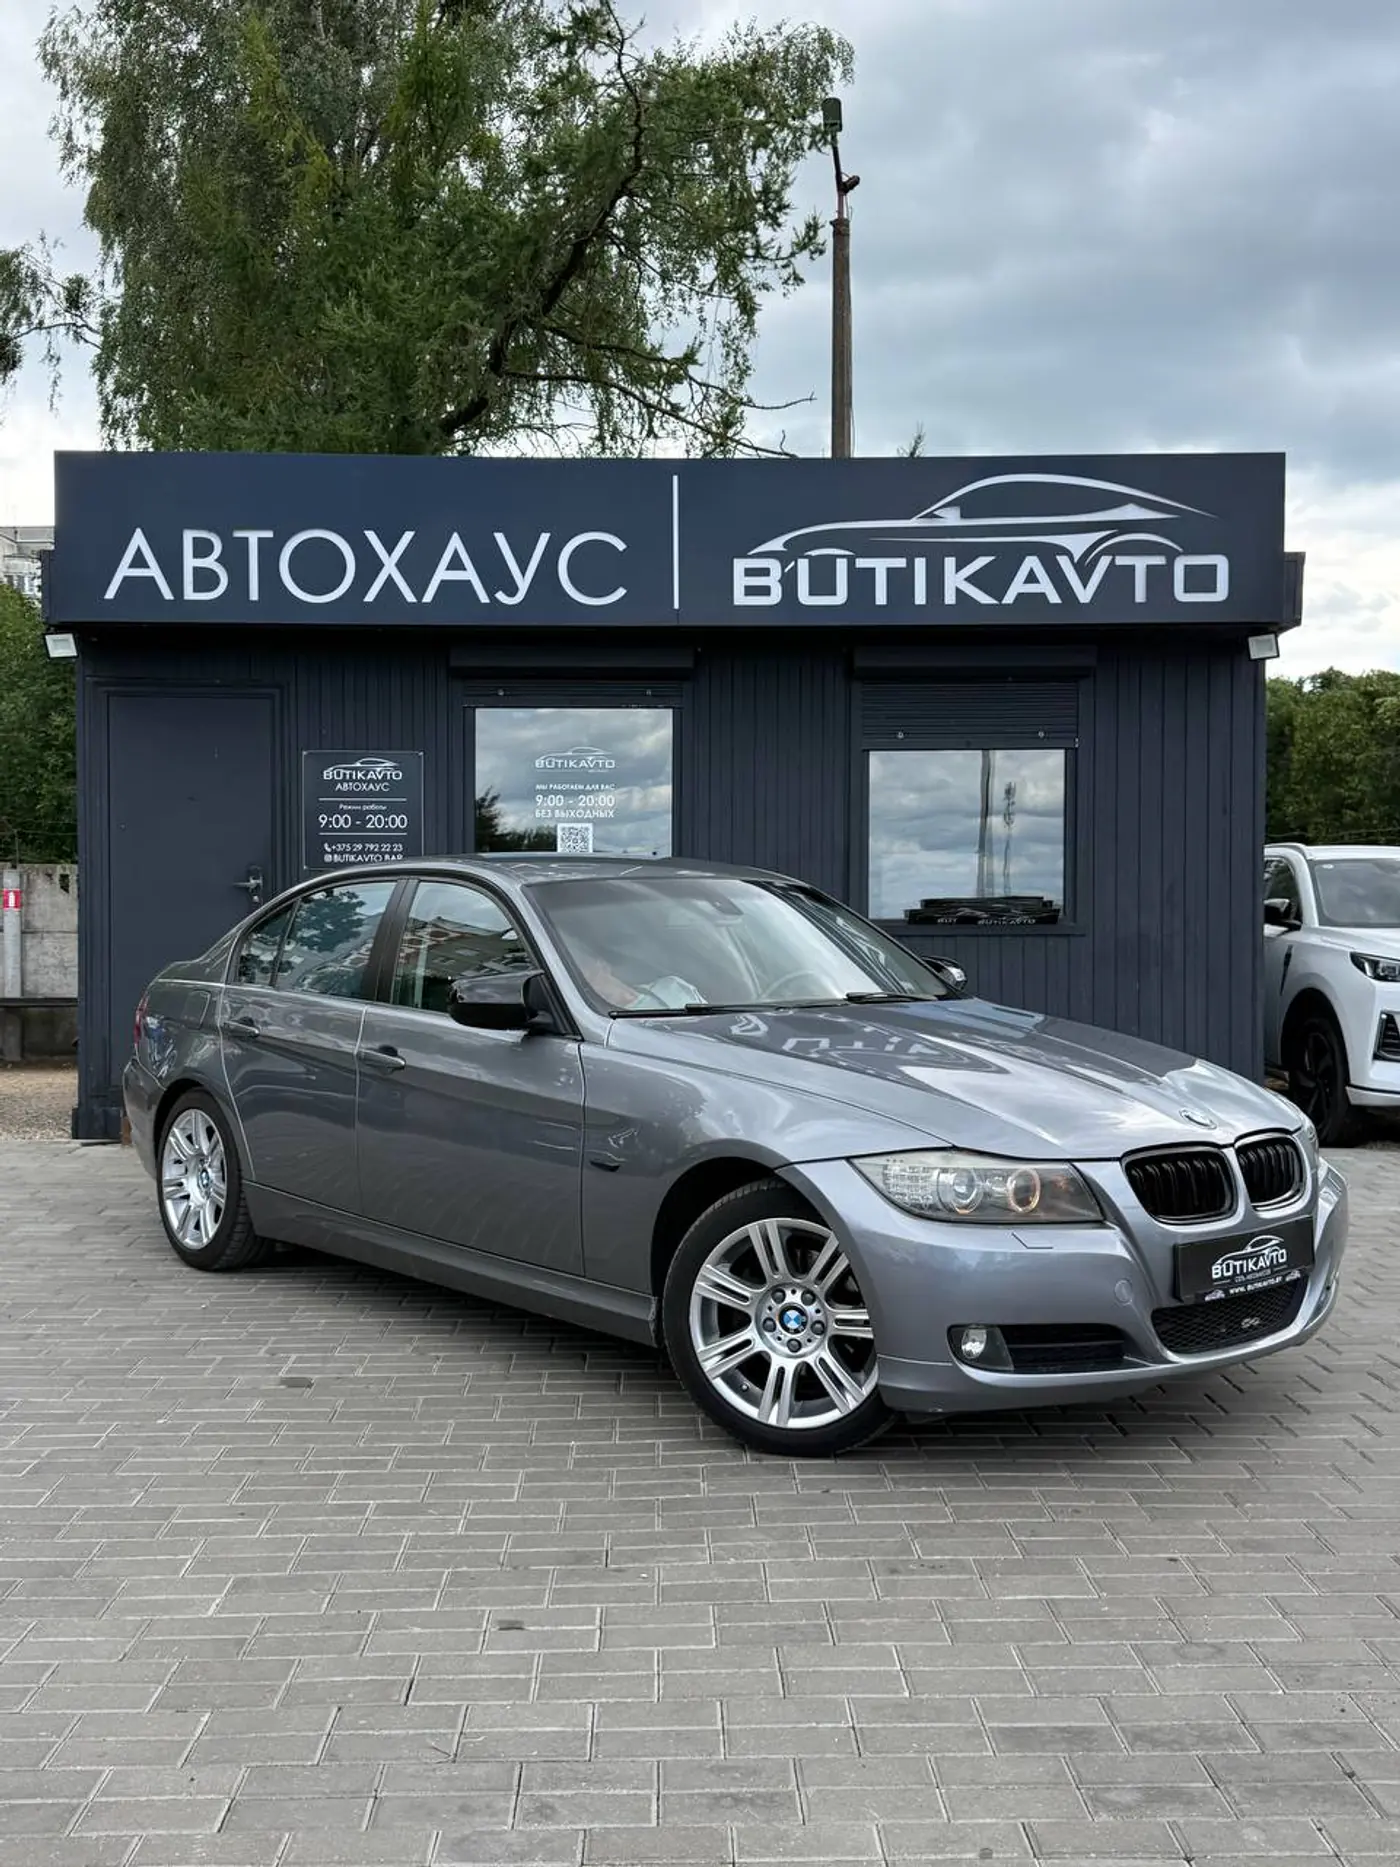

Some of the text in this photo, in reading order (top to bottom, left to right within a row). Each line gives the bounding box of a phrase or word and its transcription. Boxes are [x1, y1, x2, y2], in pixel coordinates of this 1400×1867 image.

[103, 526, 628, 607] АВТОХАУС
[733, 554, 1230, 607] BUTIKAVTO
[535, 759, 616, 769] BUTIKAVTO
[323, 769, 403, 780] BUTIKAVTO
[335, 782, 390, 792] АВТОХАУС
[535, 794, 565, 806] 9:00
[578, 794, 616, 806] 20:00
[535, 809, 615, 819] БЕЗ ВЫХОДНЫХ
[318, 814, 352, 828] 9:00
[365, 814, 408, 828] 20:00
[1211, 1249, 1288, 1279] BUTIKAVTO
